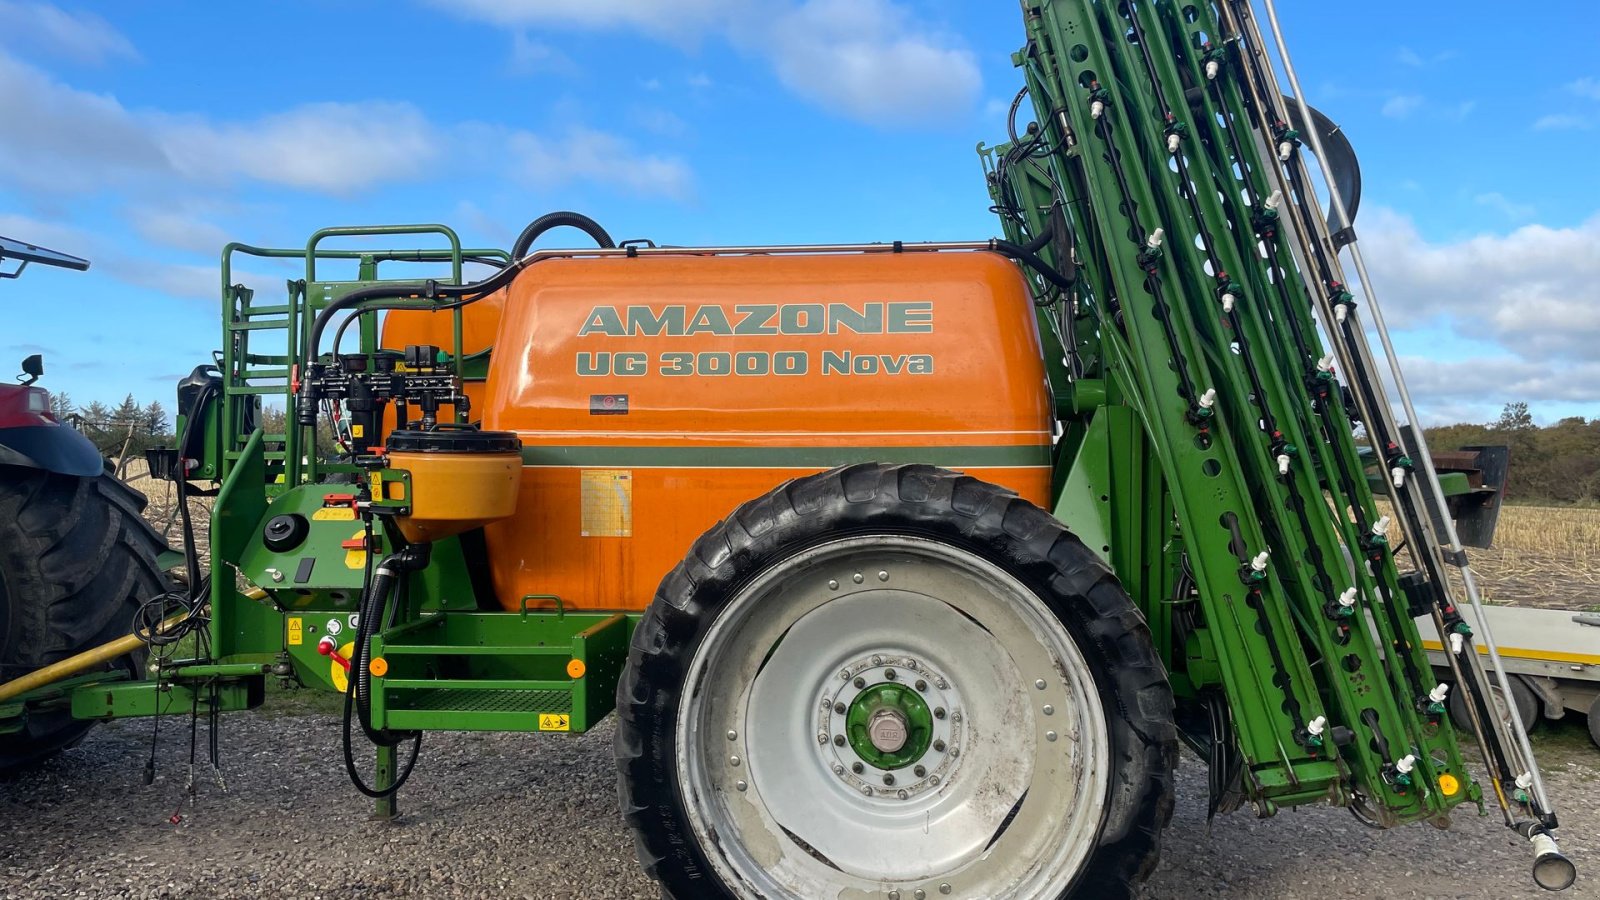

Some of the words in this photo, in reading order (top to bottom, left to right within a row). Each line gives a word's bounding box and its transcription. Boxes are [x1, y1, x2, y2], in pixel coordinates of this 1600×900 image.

[576, 302, 934, 337] AMAZONE
[576, 352, 648, 376] UG
[660, 351, 808, 376] 3000
[821, 350, 934, 375] Nova
